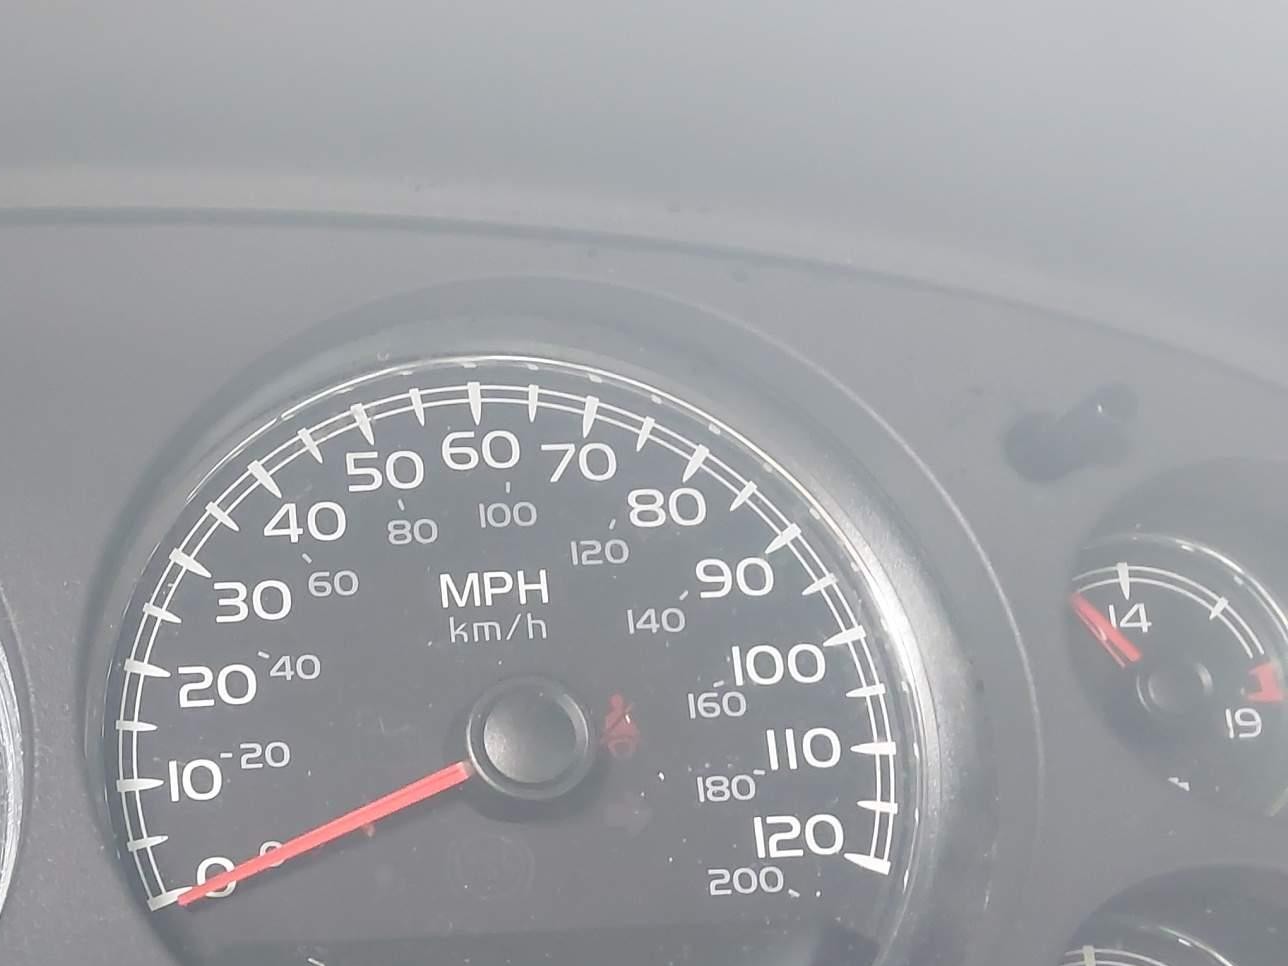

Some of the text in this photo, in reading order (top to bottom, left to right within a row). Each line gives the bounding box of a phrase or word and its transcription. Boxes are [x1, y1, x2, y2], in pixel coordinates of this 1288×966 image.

[441, 430, 521, 471] 60
[540, 441, 617, 483] 70
[344, 450, 426, 493] 50
[263, 501, 347, 543] 40
[478, 501, 538, 529] 100
[627, 487, 707, 527] 80
[387, 517, 439, 545] 80
[570, 539, 630, 566] 120
[307, 570, 360, 598] 60
[439, 569, 550, 609] MPH
[694, 557, 775, 600] 90
[213, 579, 293, 624] 30
[626, 607, 686, 635] 140
[1108, 602, 1152, 633] 14
[448, 613, 548, 644] km/h
[269, 654, 321, 682] 40
[731, 643, 826, 687] 100
[178, 664, 258, 709] 20
[687, 690, 747, 720] 160
[1224, 707, 1263, 740] 19
[239, 741, 291, 769] 20
[765, 727, 842, 771] 110
[168, 758, 224, 803] 10
[696, 774, 757, 802] 180
[752, 814, 845, 859] 120
[196, 857, 238, 899] 0
[707, 867, 785, 896] 200
